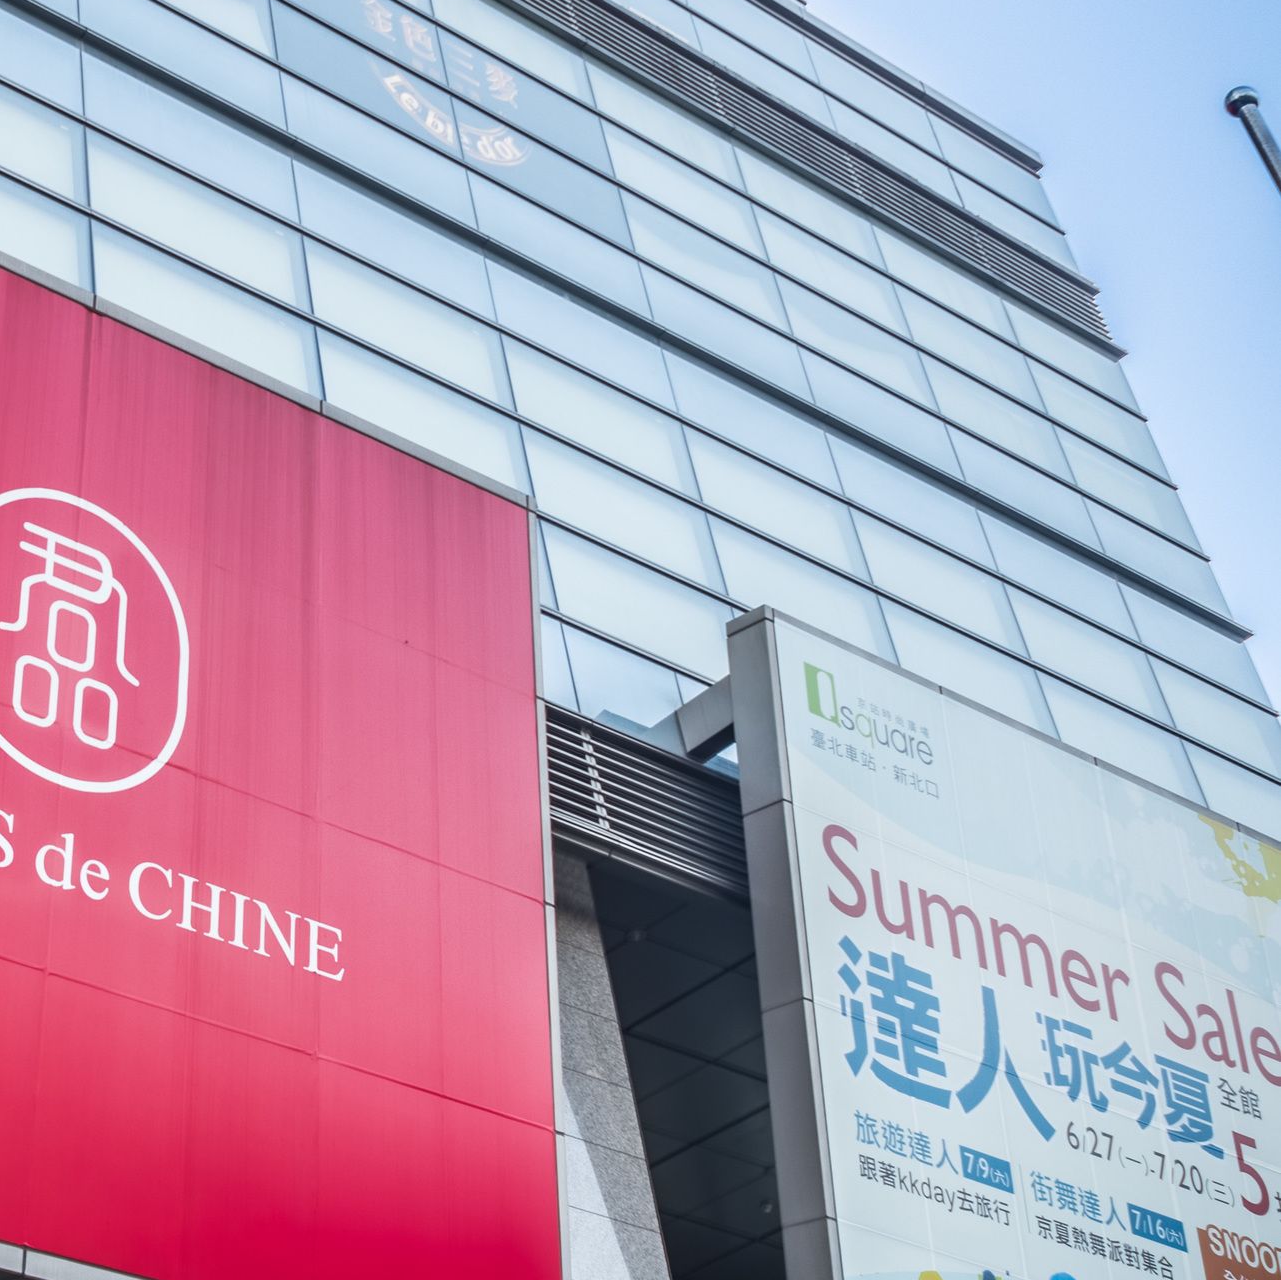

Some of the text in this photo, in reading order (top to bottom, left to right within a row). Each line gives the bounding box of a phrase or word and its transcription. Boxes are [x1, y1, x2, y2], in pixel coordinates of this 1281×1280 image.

[383, 74, 420, 111] Le
[34, 833, 110, 901] de
[128, 861, 346, 981] CHINE
[822, 823, 1281, 1088] Summer Sale
[1217, 1077, 1263, 1120] 全館
[853, 1109, 959, 1176] 旅遊達人
[1029, 1170, 1127, 1231] 街舞達人
[1207, 1225, 1281, 1276] SNOO
